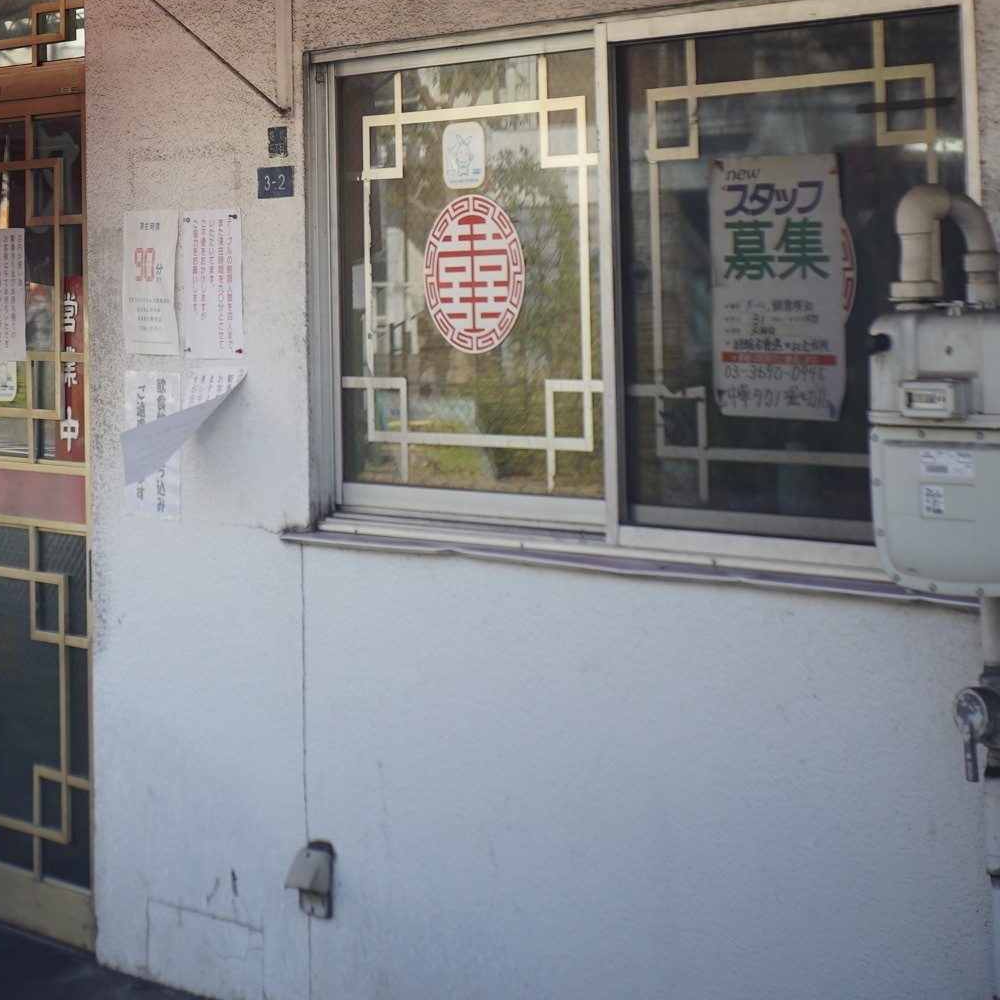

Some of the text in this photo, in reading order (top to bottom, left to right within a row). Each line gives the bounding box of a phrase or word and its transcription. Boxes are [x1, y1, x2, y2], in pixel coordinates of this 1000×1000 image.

[264, 173, 286, 191] 3-2
[726, 167, 761, 181] new
[725, 180, 824, 217] スタッフ
[723, 217, 831, 280] 募集
